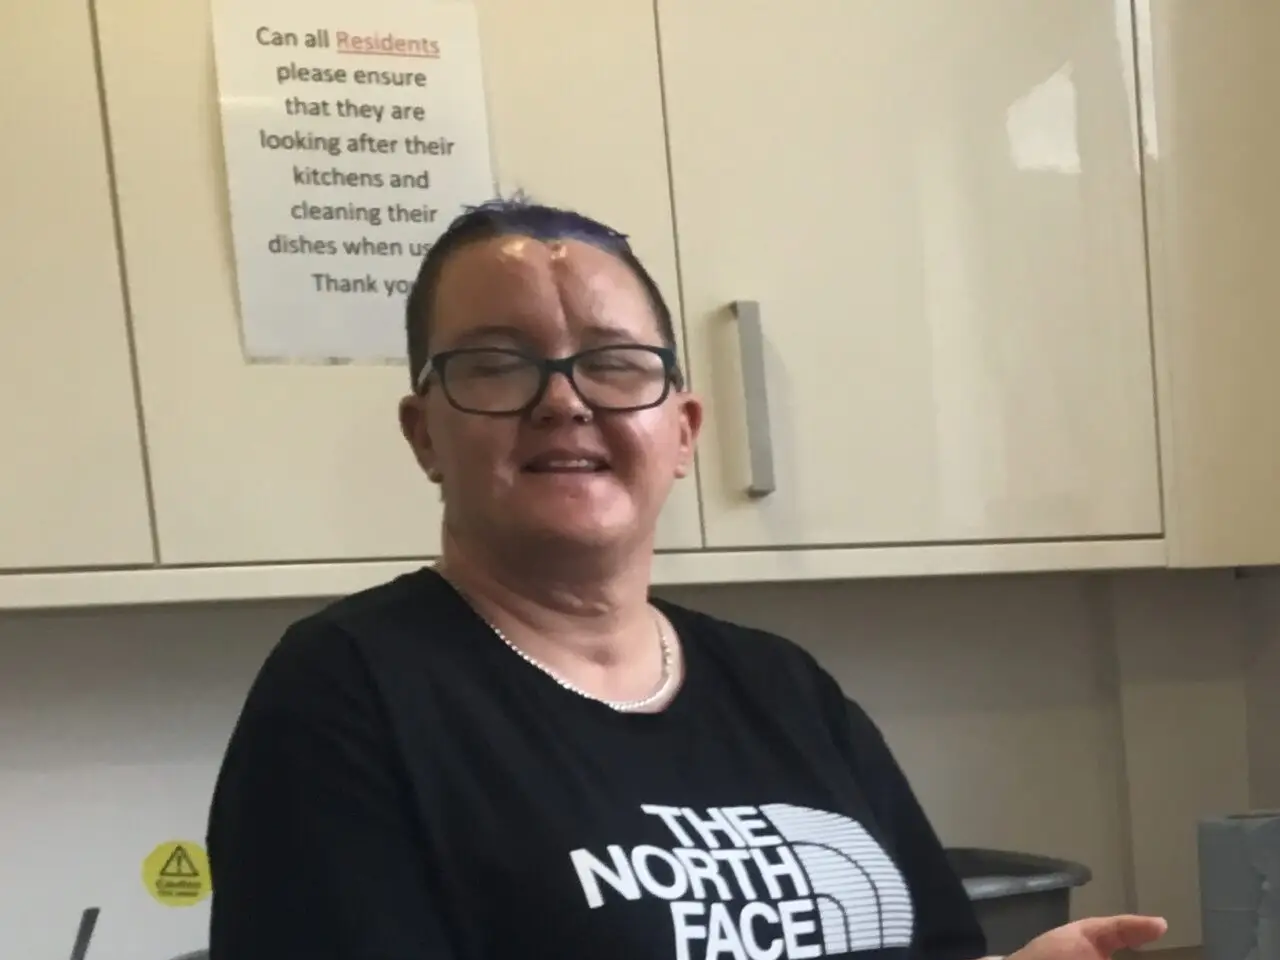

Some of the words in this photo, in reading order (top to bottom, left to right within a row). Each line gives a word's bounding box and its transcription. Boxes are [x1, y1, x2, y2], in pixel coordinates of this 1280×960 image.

[256, 26, 298, 47] Can
[304, 29, 330, 48] all
[336, 31, 441, 59] Residents
[276, 62, 347, 85] please
[353, 69, 427, 87] ensure
[285, 97, 331, 117] that
[336, 99, 384, 123] they
[391, 105, 426, 121] are
[260, 129, 341, 156] looking
[346, 132, 398, 153] after
[404, 135, 455, 156] their
[293, 165, 384, 187] kitchens
[390, 170, 429, 189] and
[291, 201, 382, 226] cleaning
[387, 203, 438, 223] their
[268, 234, 338, 255] dishes
[343, 236, 403, 256] when
[409, 242, 434, 257] us
[311, 273, 378, 293] Thank
[384, 279, 412, 297] yo
[640, 803, 784, 848] THE
[569, 844, 811, 909] NORTH
